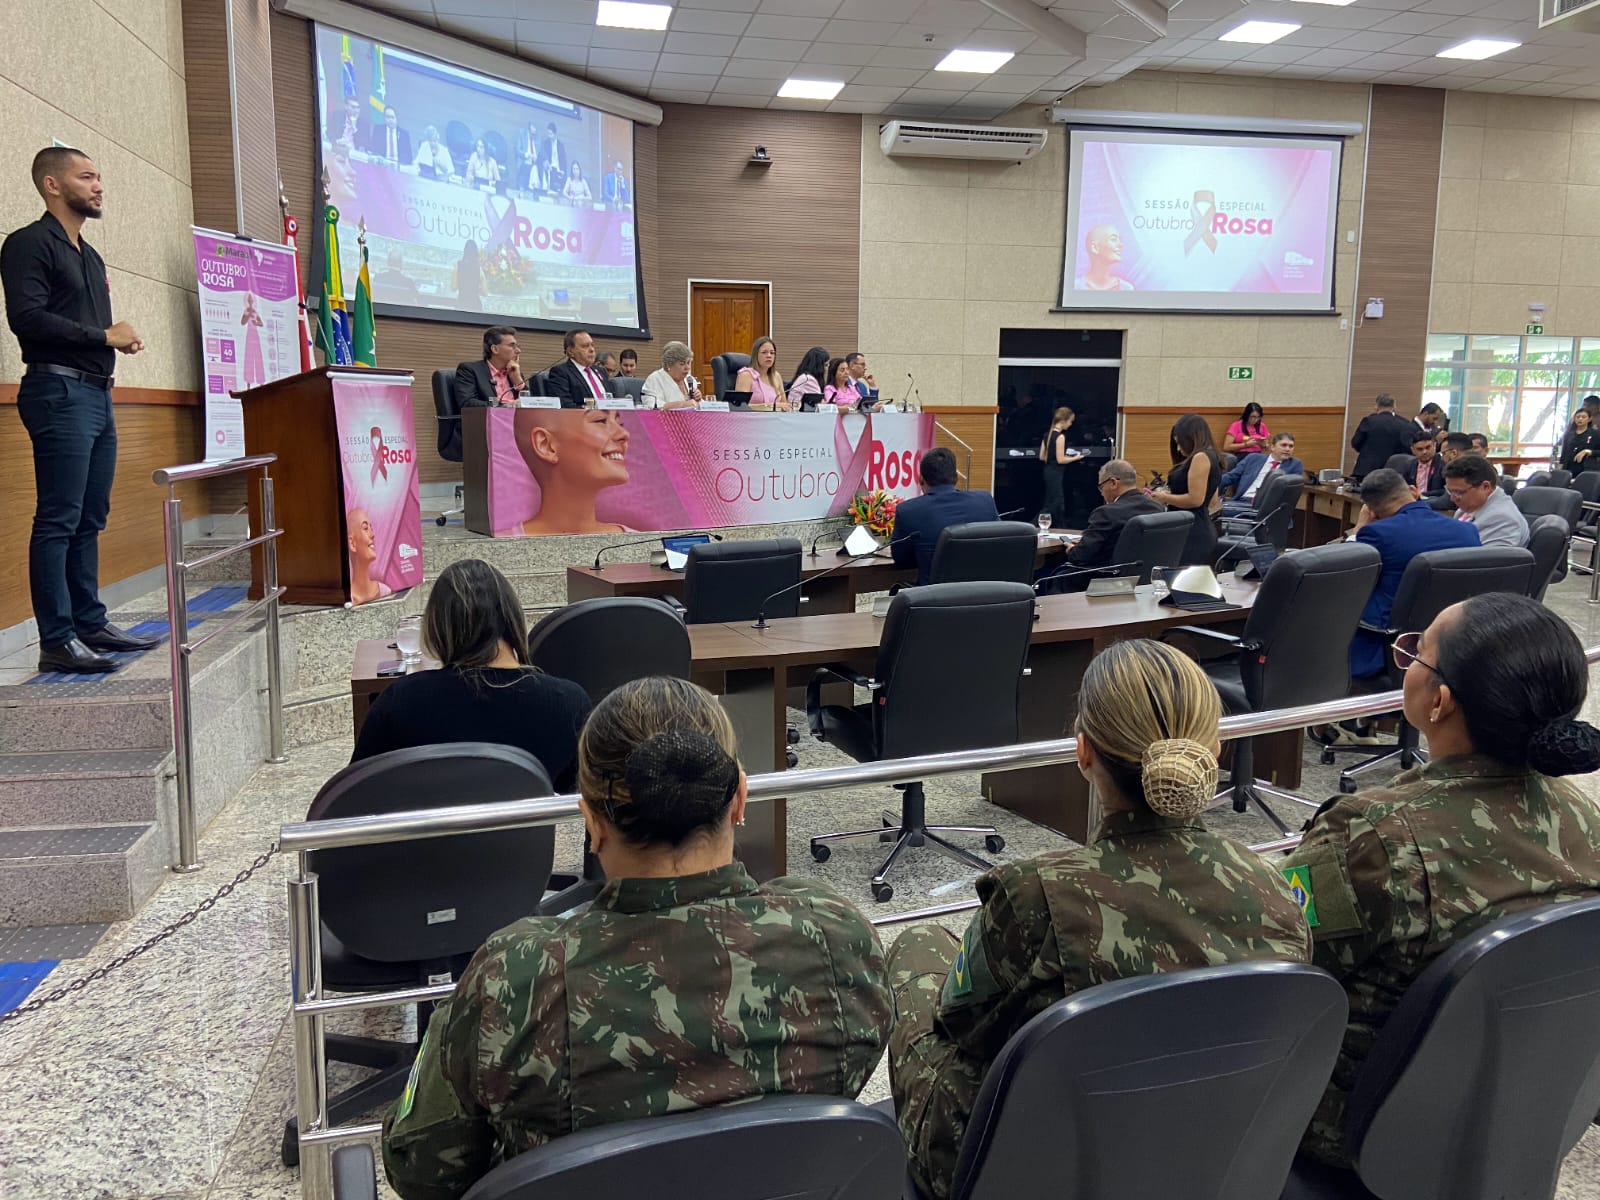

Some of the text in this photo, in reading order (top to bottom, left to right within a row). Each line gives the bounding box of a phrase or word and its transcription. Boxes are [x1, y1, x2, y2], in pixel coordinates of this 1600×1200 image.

[1144, 198, 1266, 212] SESSÃO ESPECIAL
[405, 207, 491, 242] Outubro
[514, 215, 583, 254] Rosa
[1133, 211, 1273, 236] Outubro Rosa
[201, 258, 247, 278] OUTUBRO
[202, 272, 235, 289] ROSA
[345, 434, 370, 446] SESSÃO
[382, 445, 412, 465] Rosa
[713, 446, 833, 461] SESSÃO ESPECIAL
[715, 465, 840, 503] Outubro
